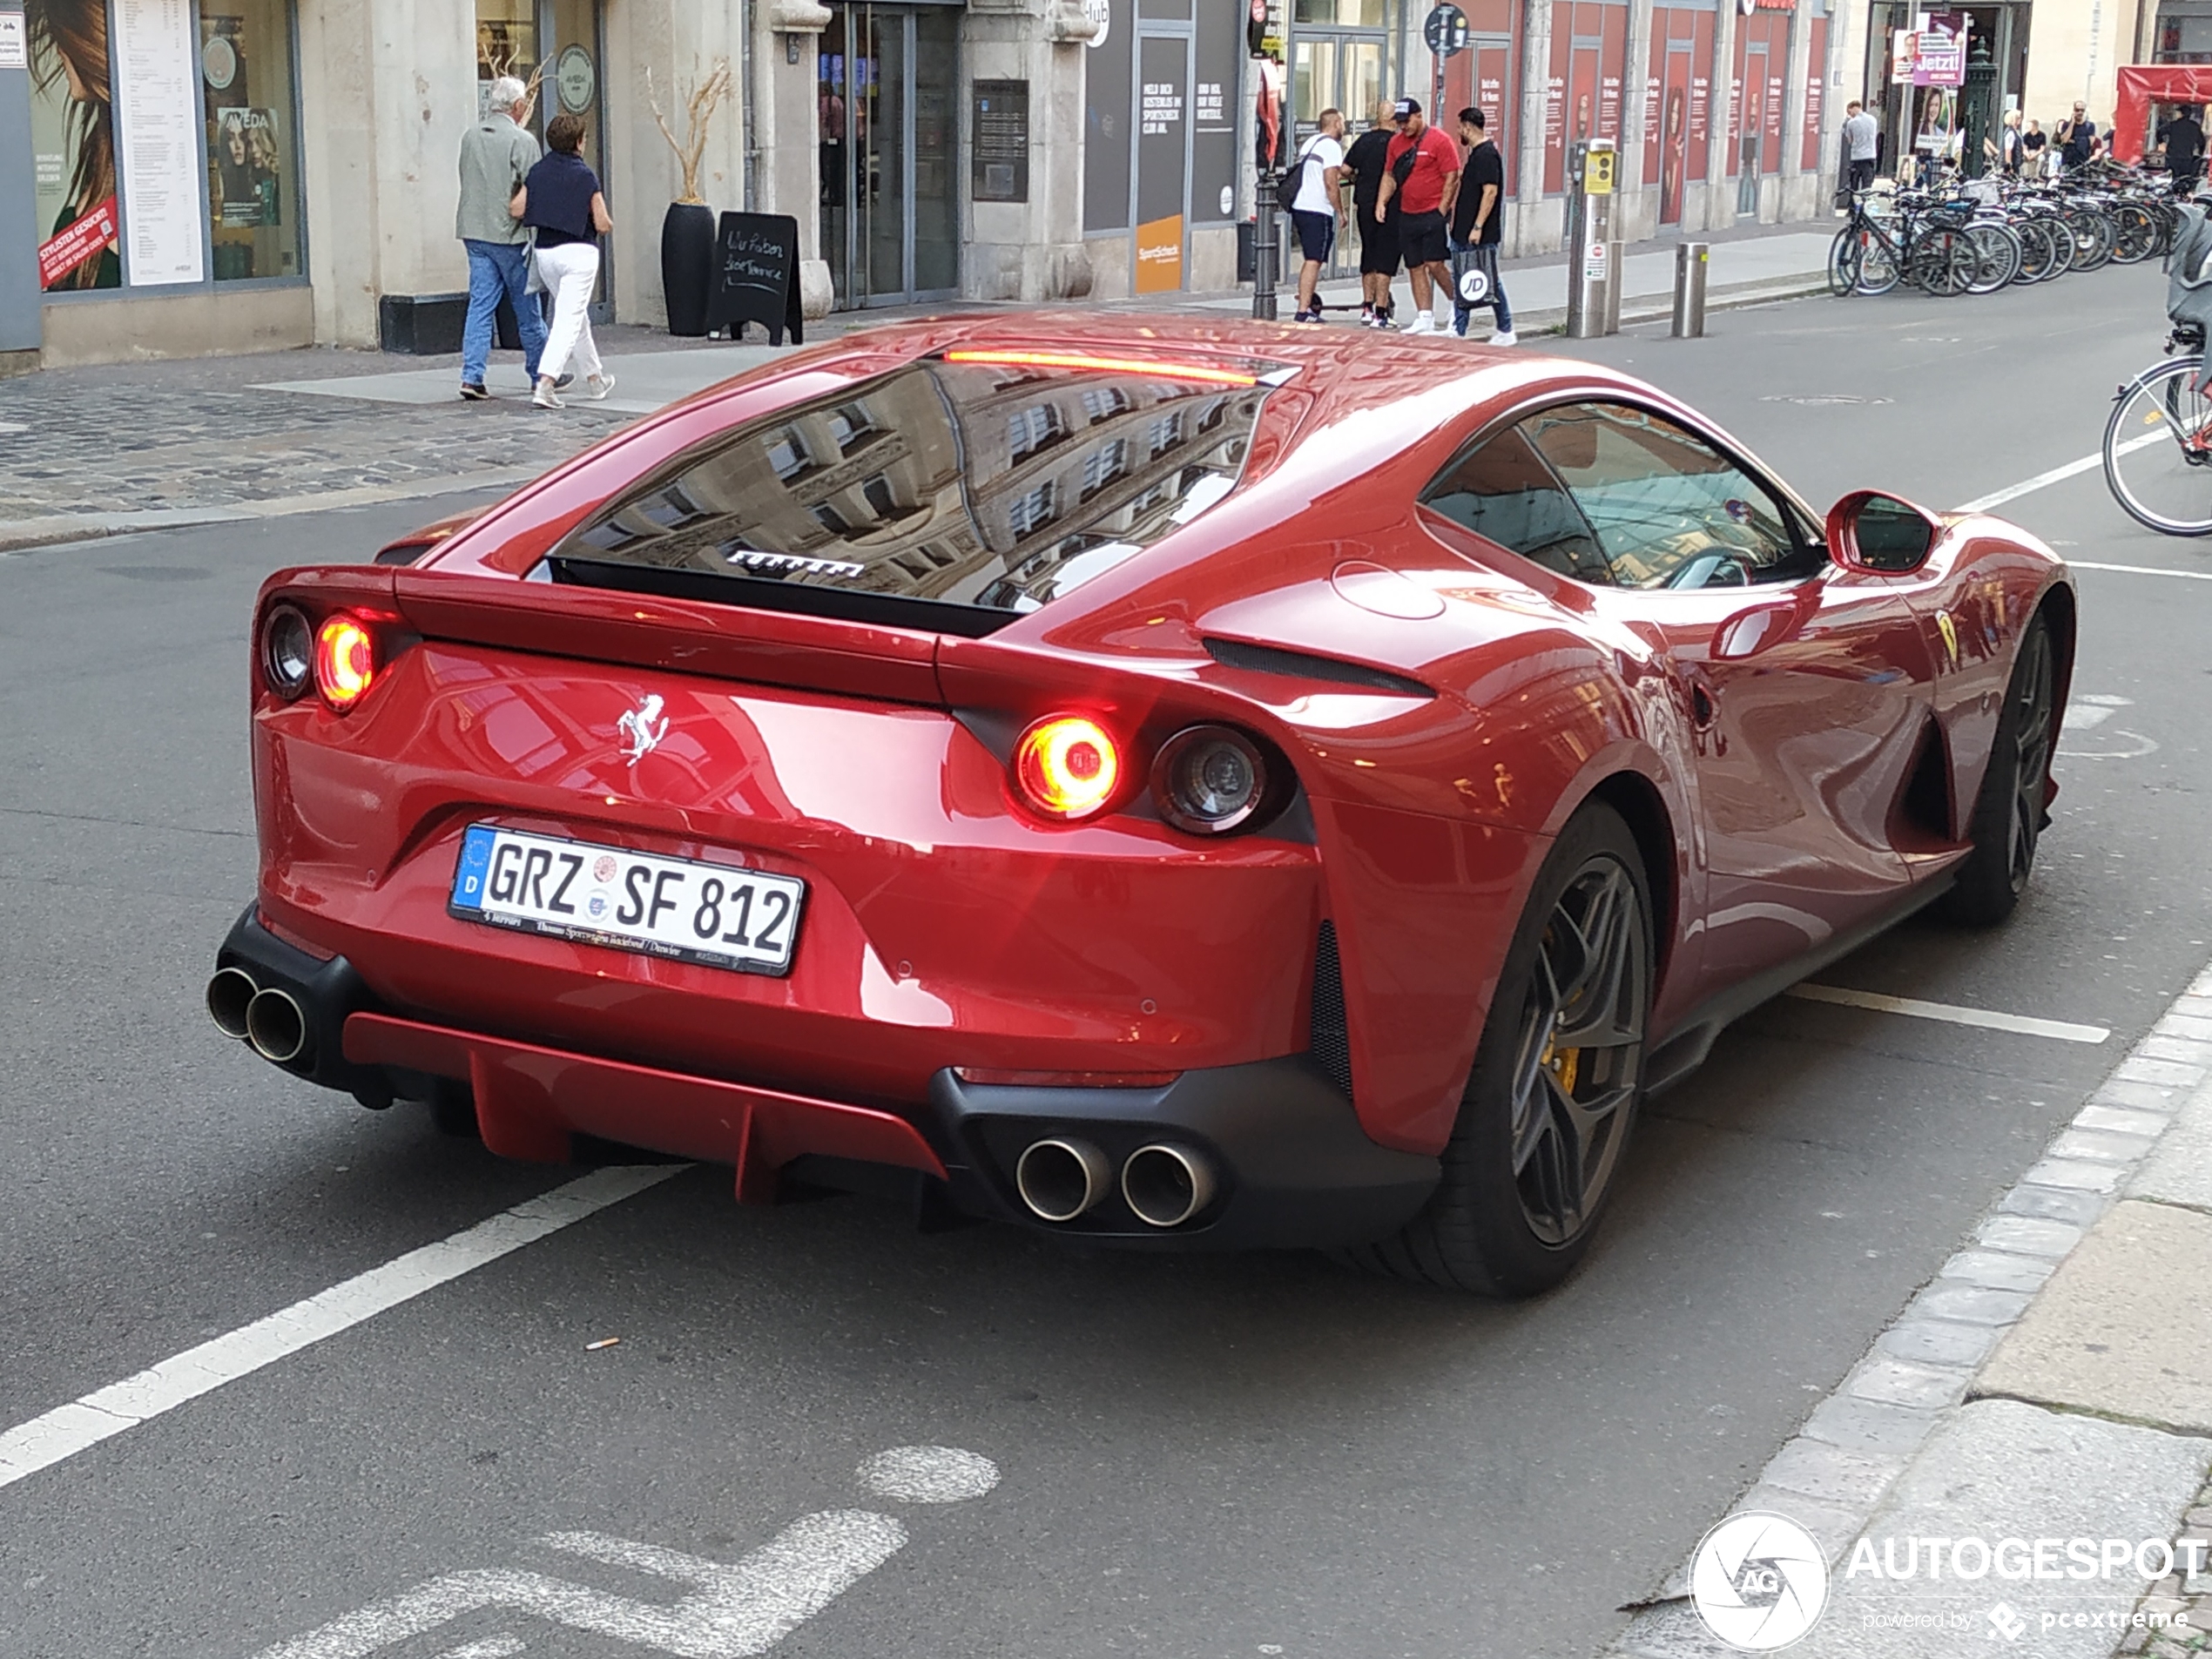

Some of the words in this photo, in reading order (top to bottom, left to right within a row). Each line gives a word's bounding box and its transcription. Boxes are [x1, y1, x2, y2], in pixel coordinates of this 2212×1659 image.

[1917, 55, 1959, 71] Jetzt!
[226, 113, 269, 128] AVEDA
[1464, 277, 1484, 295] JD
[464, 877, 477, 894] D
[489, 843, 584, 915] GRZ
[616, 865, 685, 929] SF
[693, 878, 792, 953] 812
